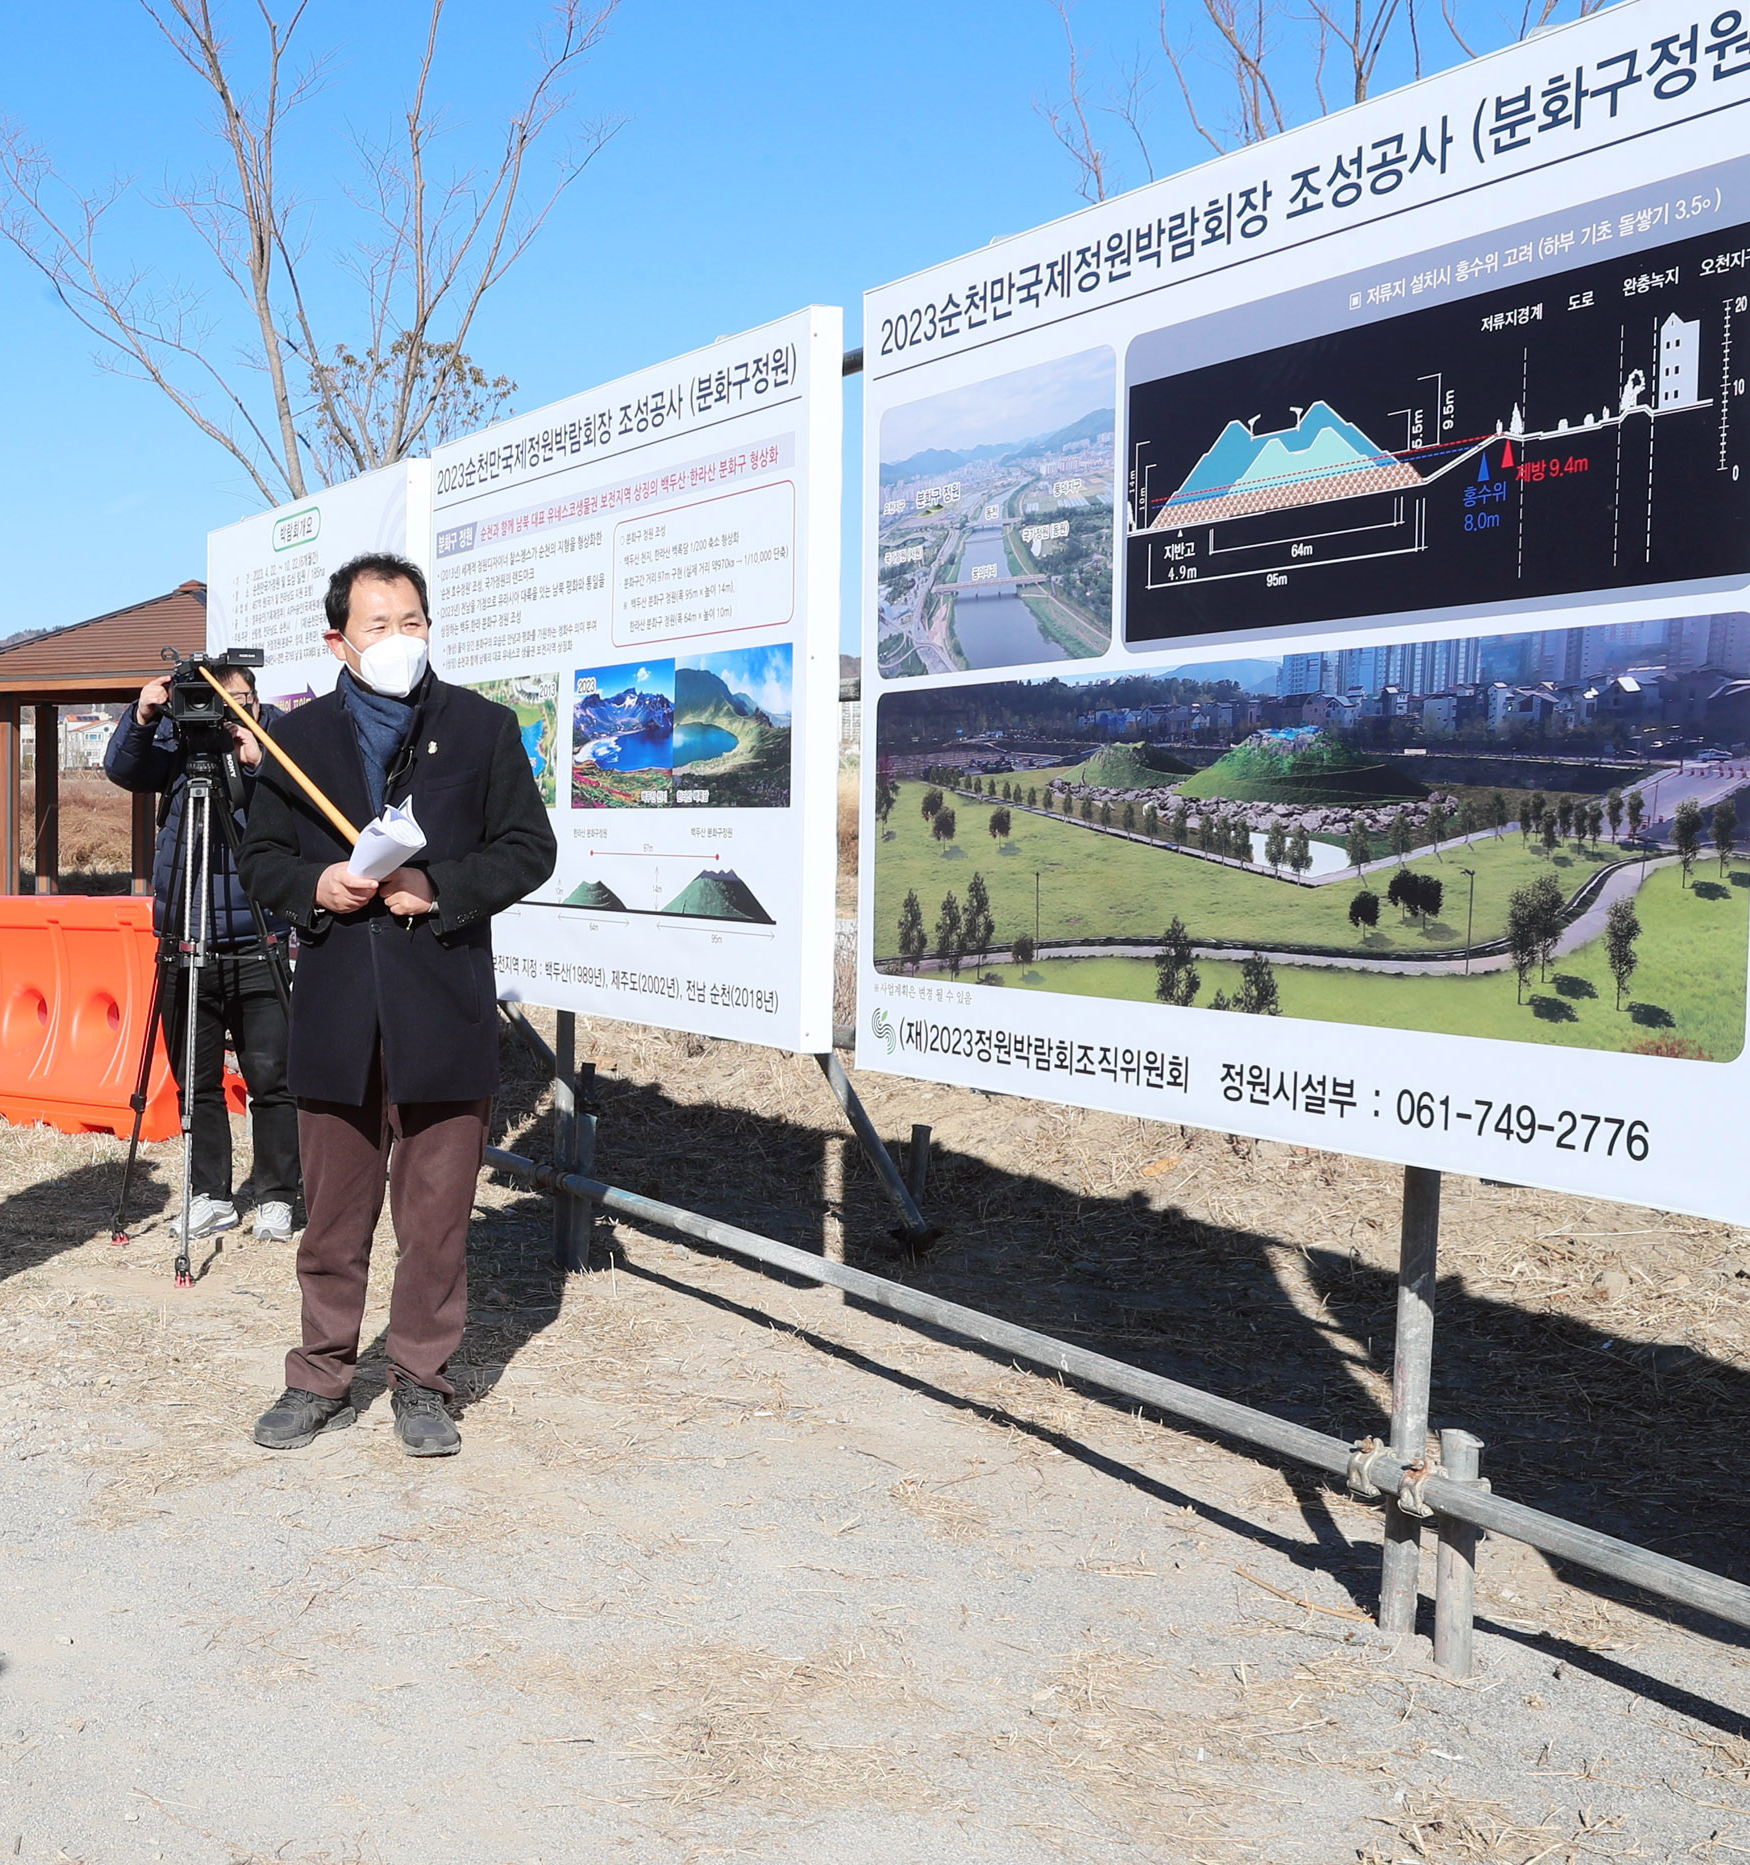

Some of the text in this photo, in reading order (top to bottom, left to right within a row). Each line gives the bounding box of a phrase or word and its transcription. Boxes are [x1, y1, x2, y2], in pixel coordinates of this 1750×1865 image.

[880, 180, 1272, 356] 2023순천만국제정원박람회장
[1286, 115, 1453, 220] 조성공사
[1366, 283, 1406, 306] 저류지
[1410, 266, 1451, 294] 설치시
[1455, 251, 1499, 280] 홍수위
[1503, 240, 1533, 269] 고려
[1538, 231, 1575, 261] (하부
[1580, 218, 1613, 247] 기초
[1618, 203, 1669, 237] 돌쌓기
[1699, 248, 1750, 276] 오천지
[1622, 266, 1679, 296] 완충녹지
[1567, 291, 1595, 312] 도로
[1735, 296, 1747, 312] 20
[1481, 302, 1543, 332] 저류지경계
[1733, 379, 1744, 396] 10
[437, 342, 798, 495] 2023순천만국제정원박람회장 조성공사 (분화구정원)
[1443, 389, 1455, 430] 9.5m
[1412, 409, 1424, 449] 5.5m
[1515, 455, 1589, 482] 제방 9.4m
[1732, 465, 1739, 481] 0
[480, 521, 500, 542] 순천과
[501, 518, 514, 537] 함께
[516, 515, 529, 532] 남북
[531, 511, 545, 527] 대표
[547, 495, 598, 523] 유네스코생물권
[600, 486, 631, 508] 보전지역
[634, 479, 658, 501] 상징의
[719, 454, 746, 478] 분화구
[750, 445, 779, 470] 형상화
[917, 483, 960, 508] 분화구 정원
[1462, 481, 1507, 507] 홍수위
[280, 516, 312, 542] 박람회개요
[1464, 512, 1500, 531] 8.0m
[438, 527, 473, 553] 분화구 정원
[539, 542, 556, 558] 순천의
[558, 537, 576, 554] 지형을
[578, 531, 602, 550] 형상화한
[626, 524, 666, 545] 분화구 정원 조성
[624, 552, 640, 566] 백두산
[655, 546, 670, 561] 한라산
[690, 538, 707, 552] 1/200
[708, 536, 719, 549] 축소
[722, 531, 739, 547] 형상화
[1163, 542, 1196, 560] 지반고
[1291, 542, 1313, 558] 64m
[512, 568, 534, 584] 랜드마크
[586, 573, 605, 590] 통일을
[624, 574, 645, 590] 분화구간
[646, 571, 656, 584] 거리
[658, 570, 670, 582] 97m
[699, 561, 710, 574] 거리
[744, 550, 772, 566] 1/10,000
[1167, 565, 1197, 580] 4.9m
[1266, 572, 1288, 587] 95m
[631, 597, 647, 610] 백두산
[648, 593, 664, 607] 분화구
[511, 610, 521, 624] 조성
[630, 619, 645, 632] 한라산
[647, 615, 662, 630] 분화구
[540, 683, 556, 698] 2013
[578, 679, 596, 694] 2023
[226, 754, 236, 778] SONY
[691, 828, 733, 838] 백두산 분화구정원
[522, 958, 537, 978] 지정
[545, 961, 608, 989] 백두산(1989년),
[611, 970, 682, 1000] 제주도(2002년),
[686, 979, 706, 1003] 전남
[710, 982, 779, 1014] 순천(2018년)
[919, 987, 932, 1001] 변경
[946, 990, 953, 1003] 수
[957, 991, 972, 1005] 있음
[900, 1016, 1189, 1094] (재)2023정원박람회조직위원회
[1220, 1061, 1358, 1120] 정원시설부
[1396, 1086, 1650, 1162] 061-749-2776
